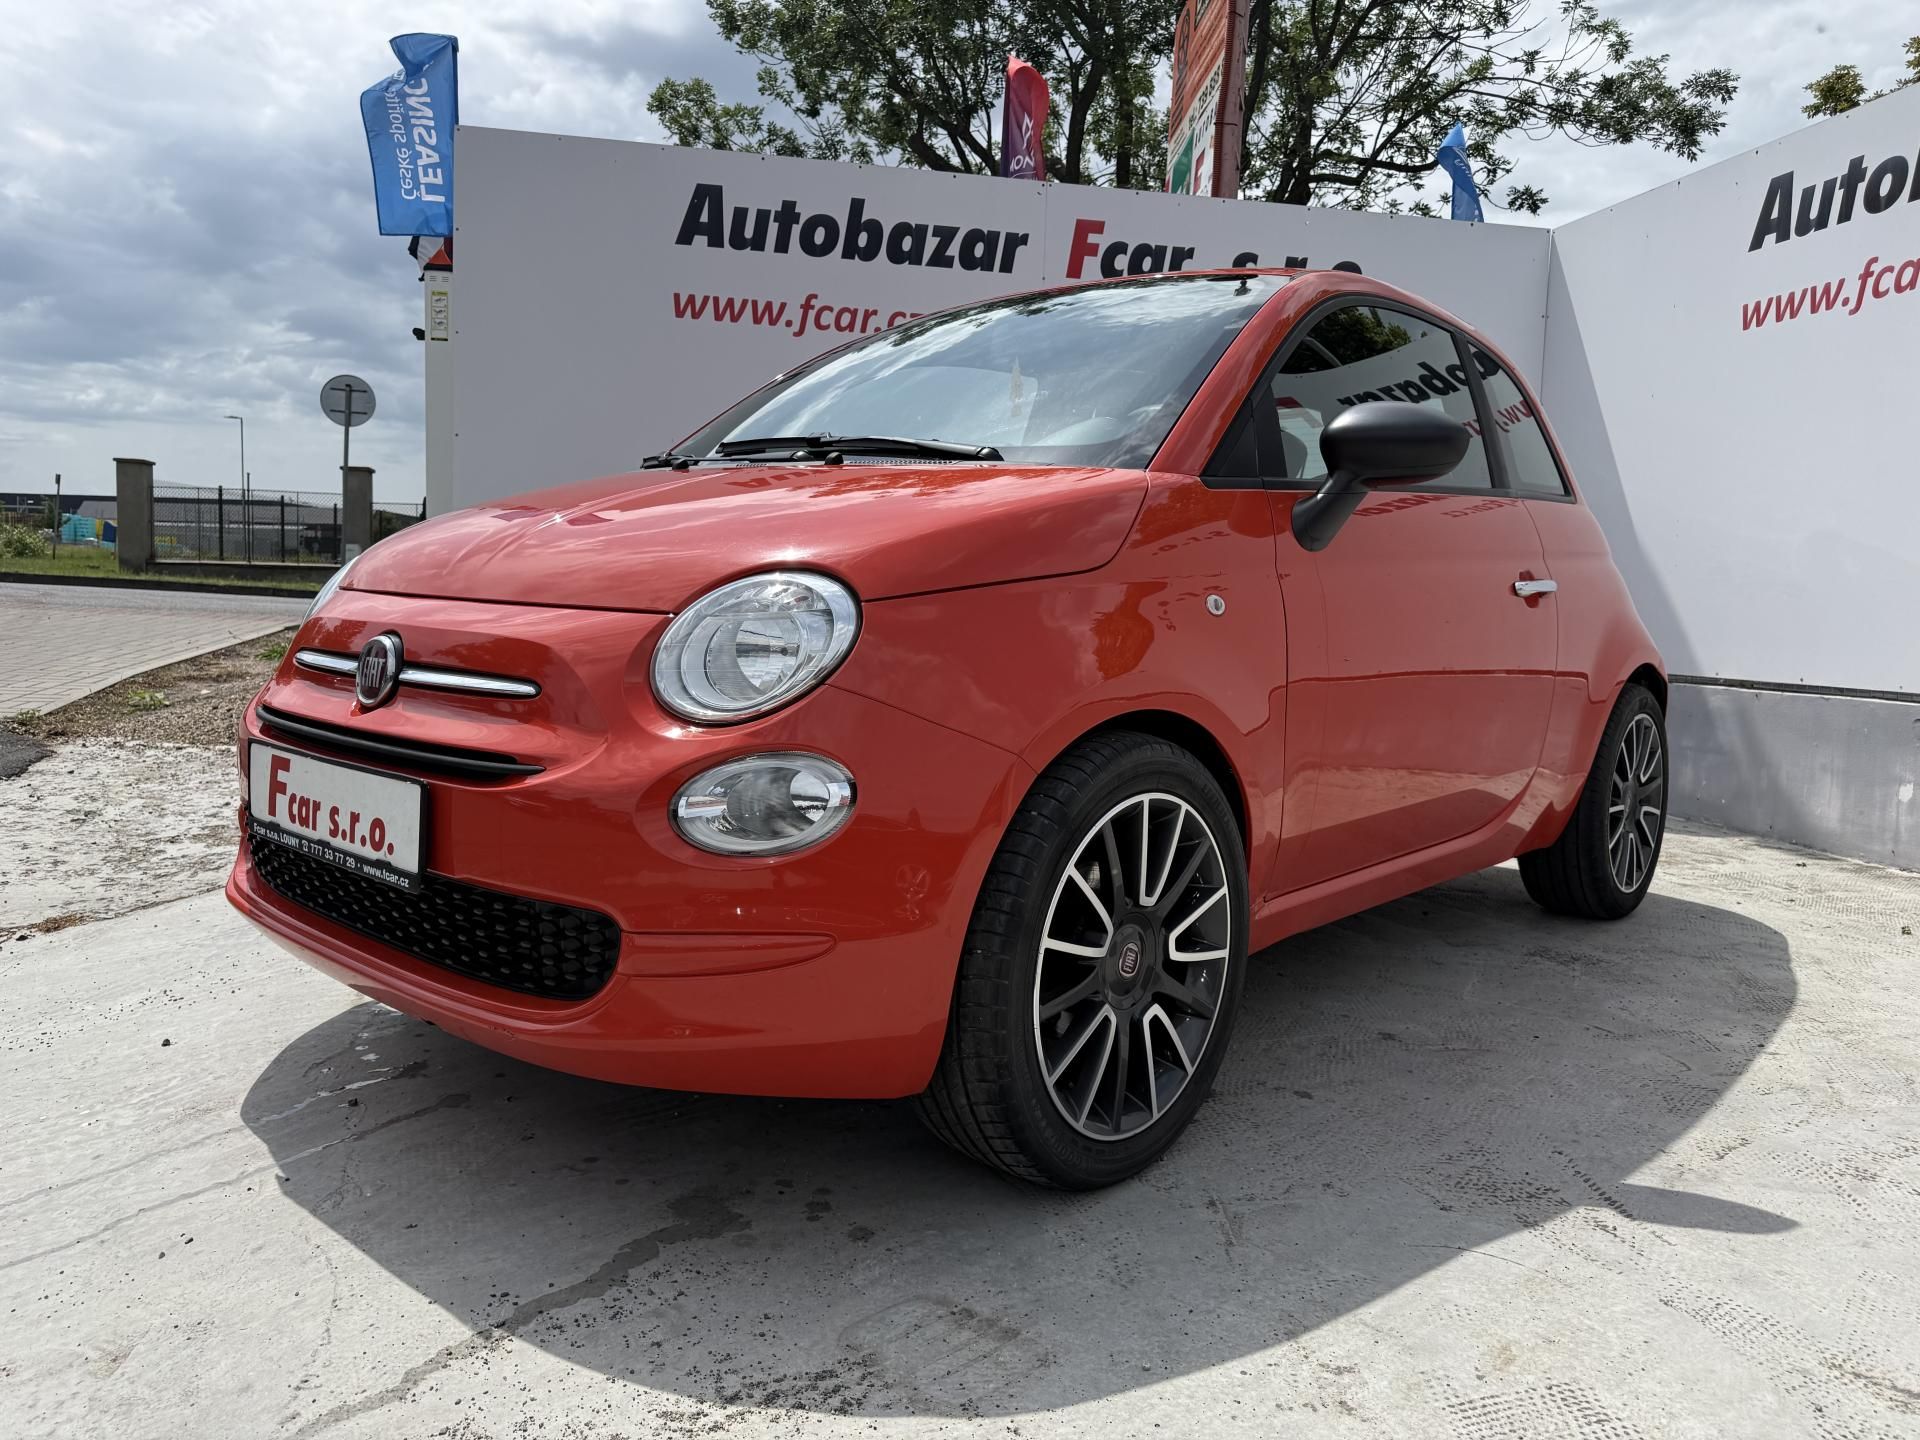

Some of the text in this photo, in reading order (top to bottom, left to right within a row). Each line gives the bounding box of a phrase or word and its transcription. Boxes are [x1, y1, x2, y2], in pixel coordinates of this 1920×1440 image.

[674, 182, 1196, 280] Autobazar Fcar
[672, 291, 927, 338] www.fcar.c
[1741, 255, 1920, 332] www.fca
[361, 656, 386, 688] FIAT
[267, 753, 395, 856] Fcar s.r.o.
[280, 832, 300, 849] LOUNY
[310, 843, 323, 857] 777
[324, 848, 334, 860] 33
[335, 852, 344, 865] 77
[346, 856, 355, 869] 29
[362, 863, 409, 888] www.fcar.cz
[1123, 950, 1136, 973] FIAT
